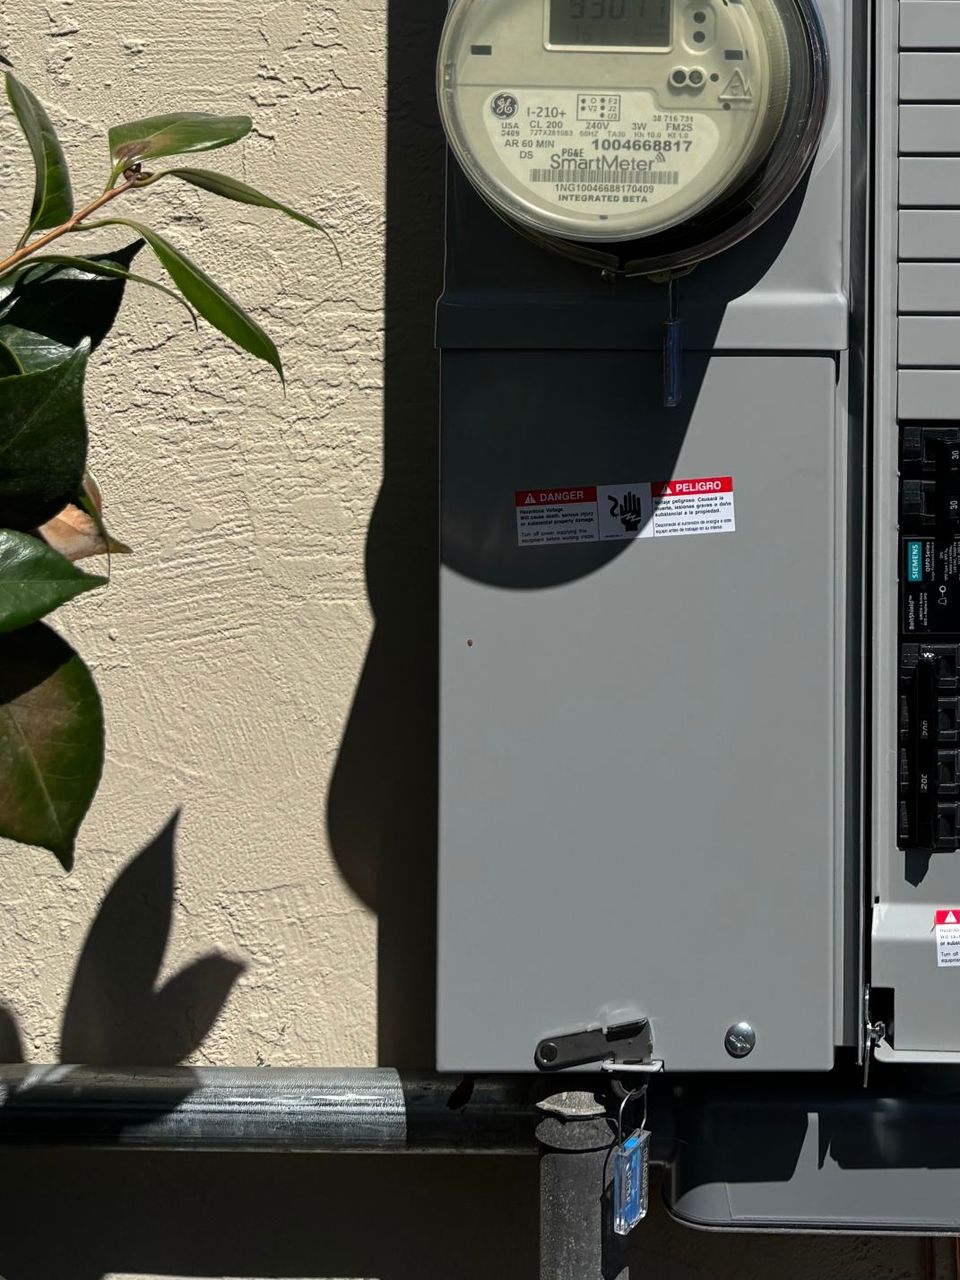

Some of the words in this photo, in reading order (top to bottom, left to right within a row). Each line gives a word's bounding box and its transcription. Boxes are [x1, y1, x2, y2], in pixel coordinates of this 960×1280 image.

[527, 106, 566, 118] I-210+
[529, 120, 542, 128] CL
[666, 123, 693, 131] FM2S
[592, 139, 692, 152] 1004668817
[520, 151, 534, 159] DS
[562, 148, 584, 157] PG&E
[550, 154, 655, 170] SmartMeter
[558, 194, 620, 202] INTEGRATED
[951, 450, 959, 460] 30
[676, 481, 722, 493] PELIGRO
[540, 491, 584, 502] DANGER
[950, 500, 958, 510] 30
[911, 544, 919, 579] SIEMENS
